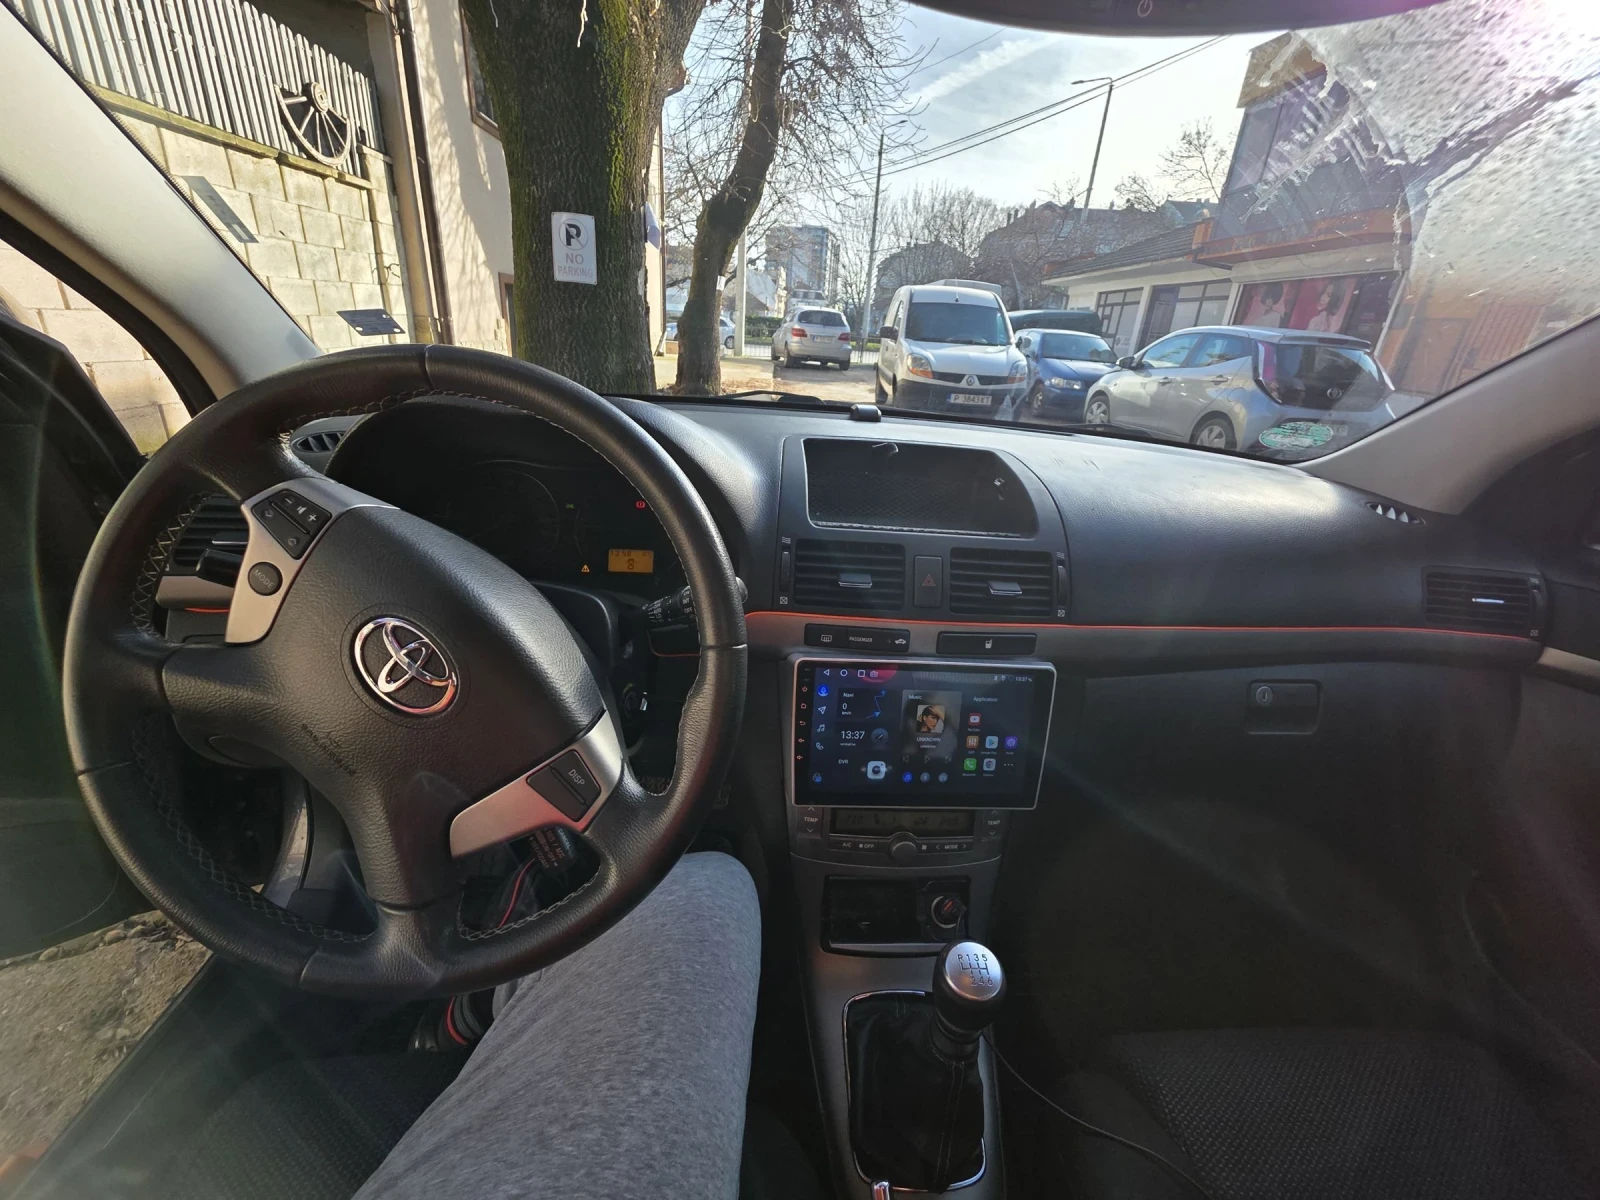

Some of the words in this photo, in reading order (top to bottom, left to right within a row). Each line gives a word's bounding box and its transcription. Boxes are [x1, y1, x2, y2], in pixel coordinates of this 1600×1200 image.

[565, 252, 584, 265] NO
[557, 265, 593, 278] PARKING
[253, 569, 276, 589] MODE
[841, 730, 865, 740] 13:37
[568, 768, 585, 785] DISP
